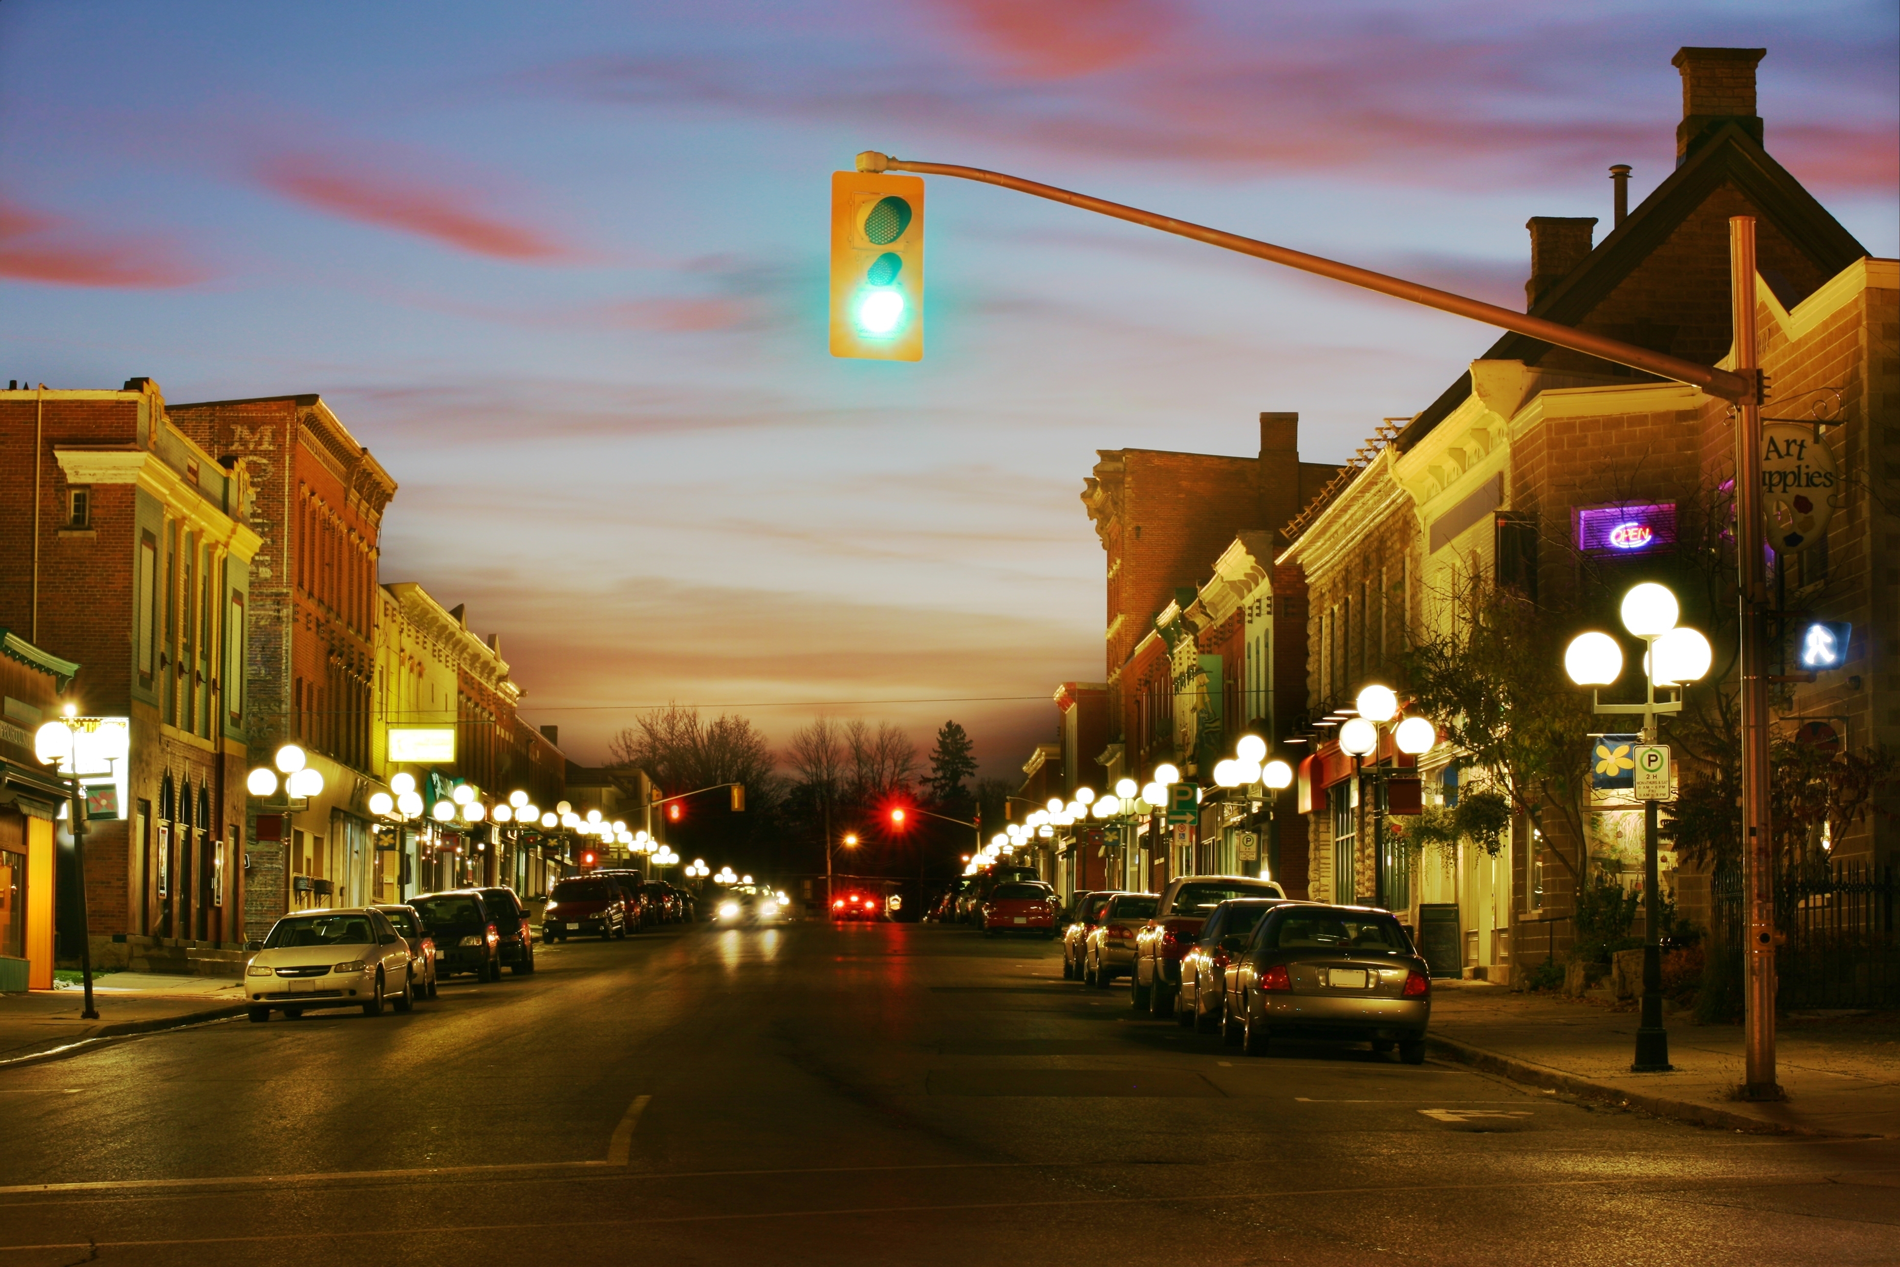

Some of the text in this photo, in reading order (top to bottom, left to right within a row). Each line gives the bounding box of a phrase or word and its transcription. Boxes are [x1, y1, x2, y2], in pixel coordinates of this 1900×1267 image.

[1763, 435, 1806, 461] Art
[1762, 464, 1834, 493] pplies
[1614, 527, 1650, 542] OPEN
[1648, 754, 1658, 767] P
[1173, 786, 1193, 810] P
